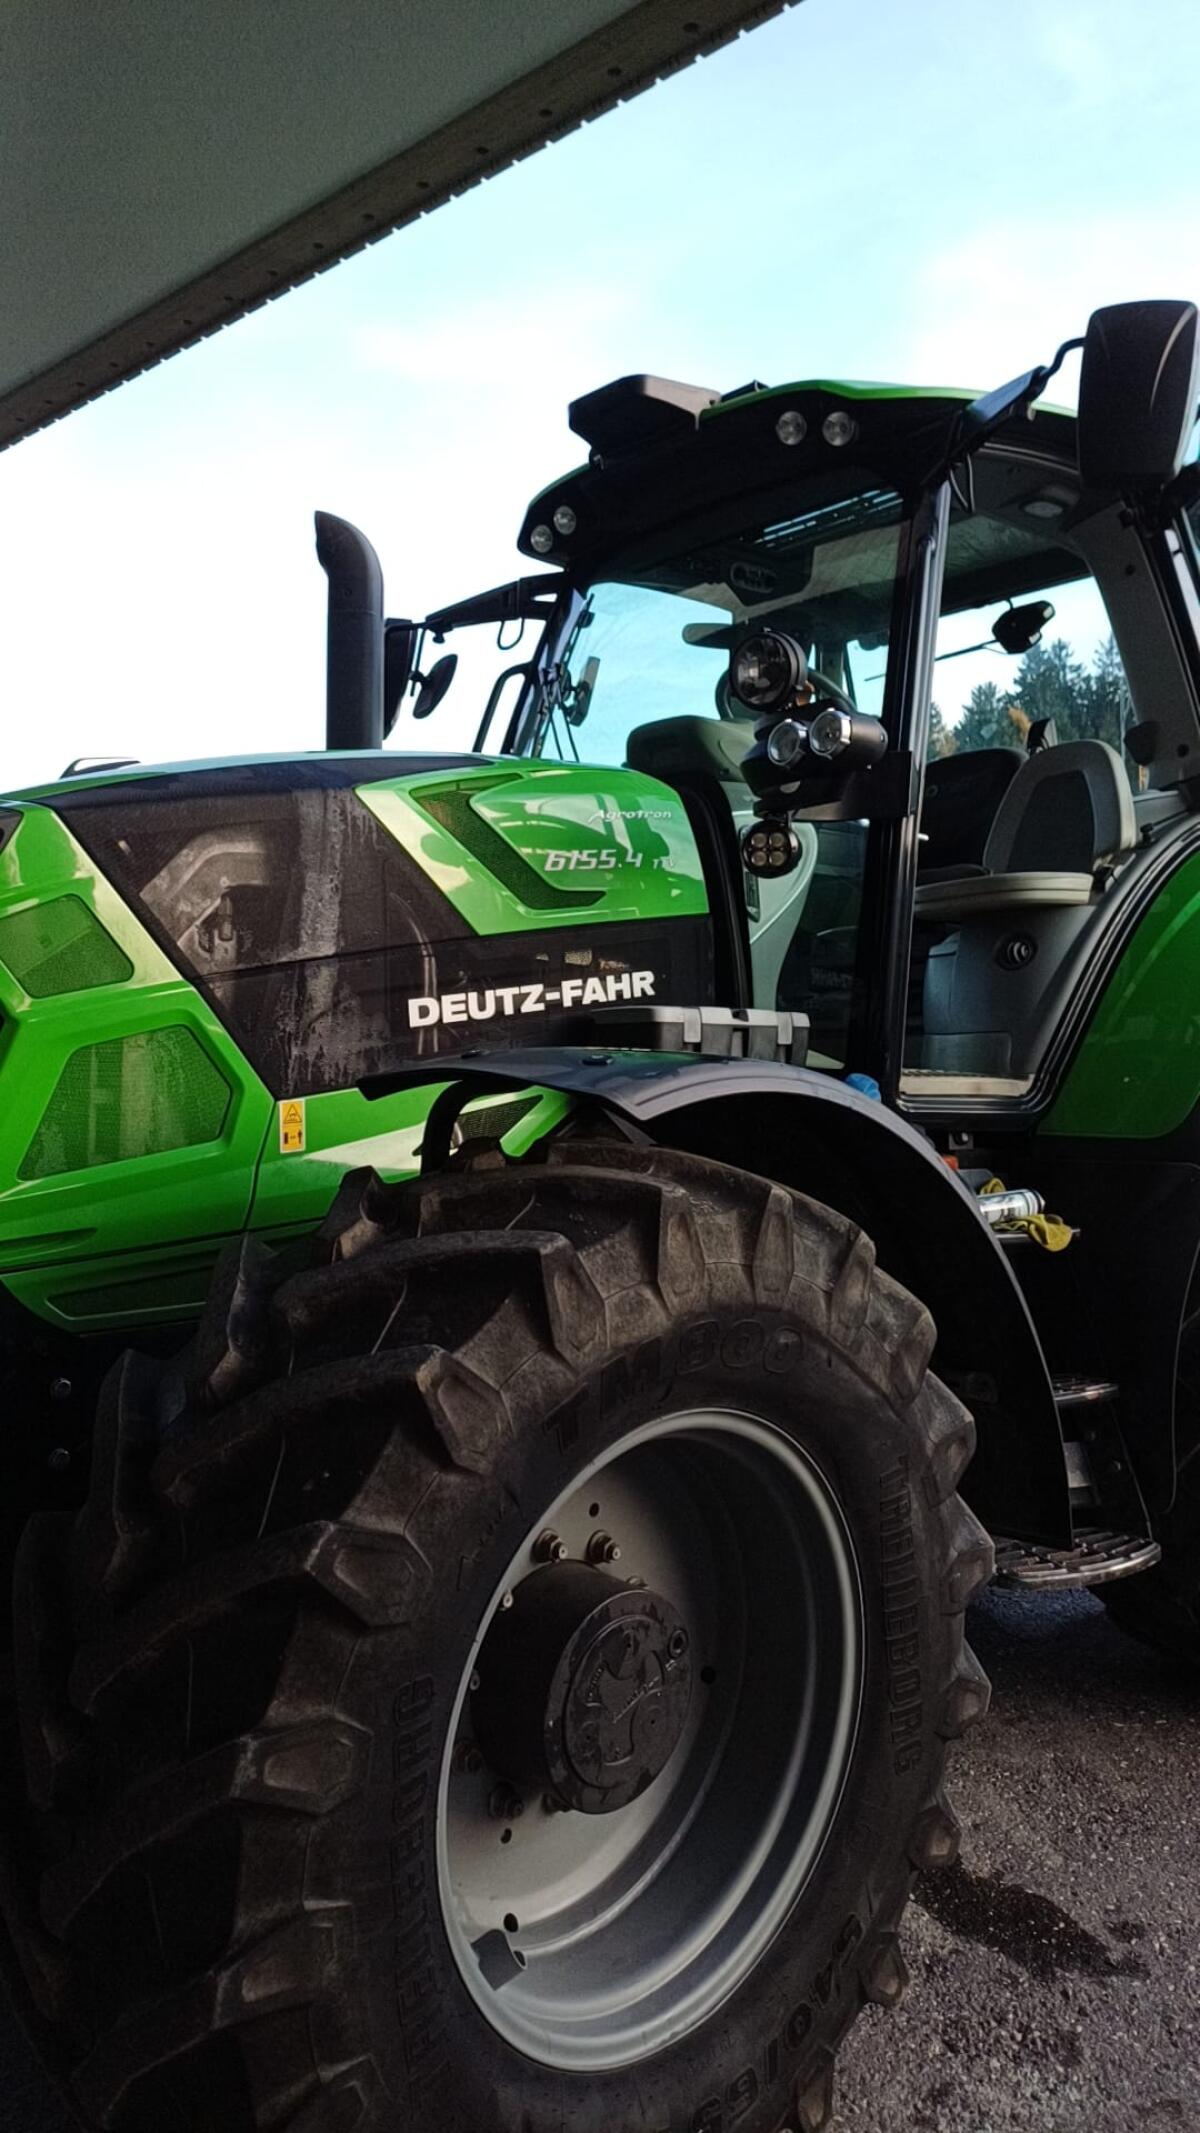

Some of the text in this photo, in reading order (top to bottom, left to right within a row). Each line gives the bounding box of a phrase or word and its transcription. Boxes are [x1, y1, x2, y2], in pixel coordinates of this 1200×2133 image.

[588, 809, 672, 824] Agrotron
[544, 850, 643, 871] 6155.4
[408, 970, 655, 1029] DEUTZ-FAHR
[878, 1453, 923, 1777] TRELLEBORG
